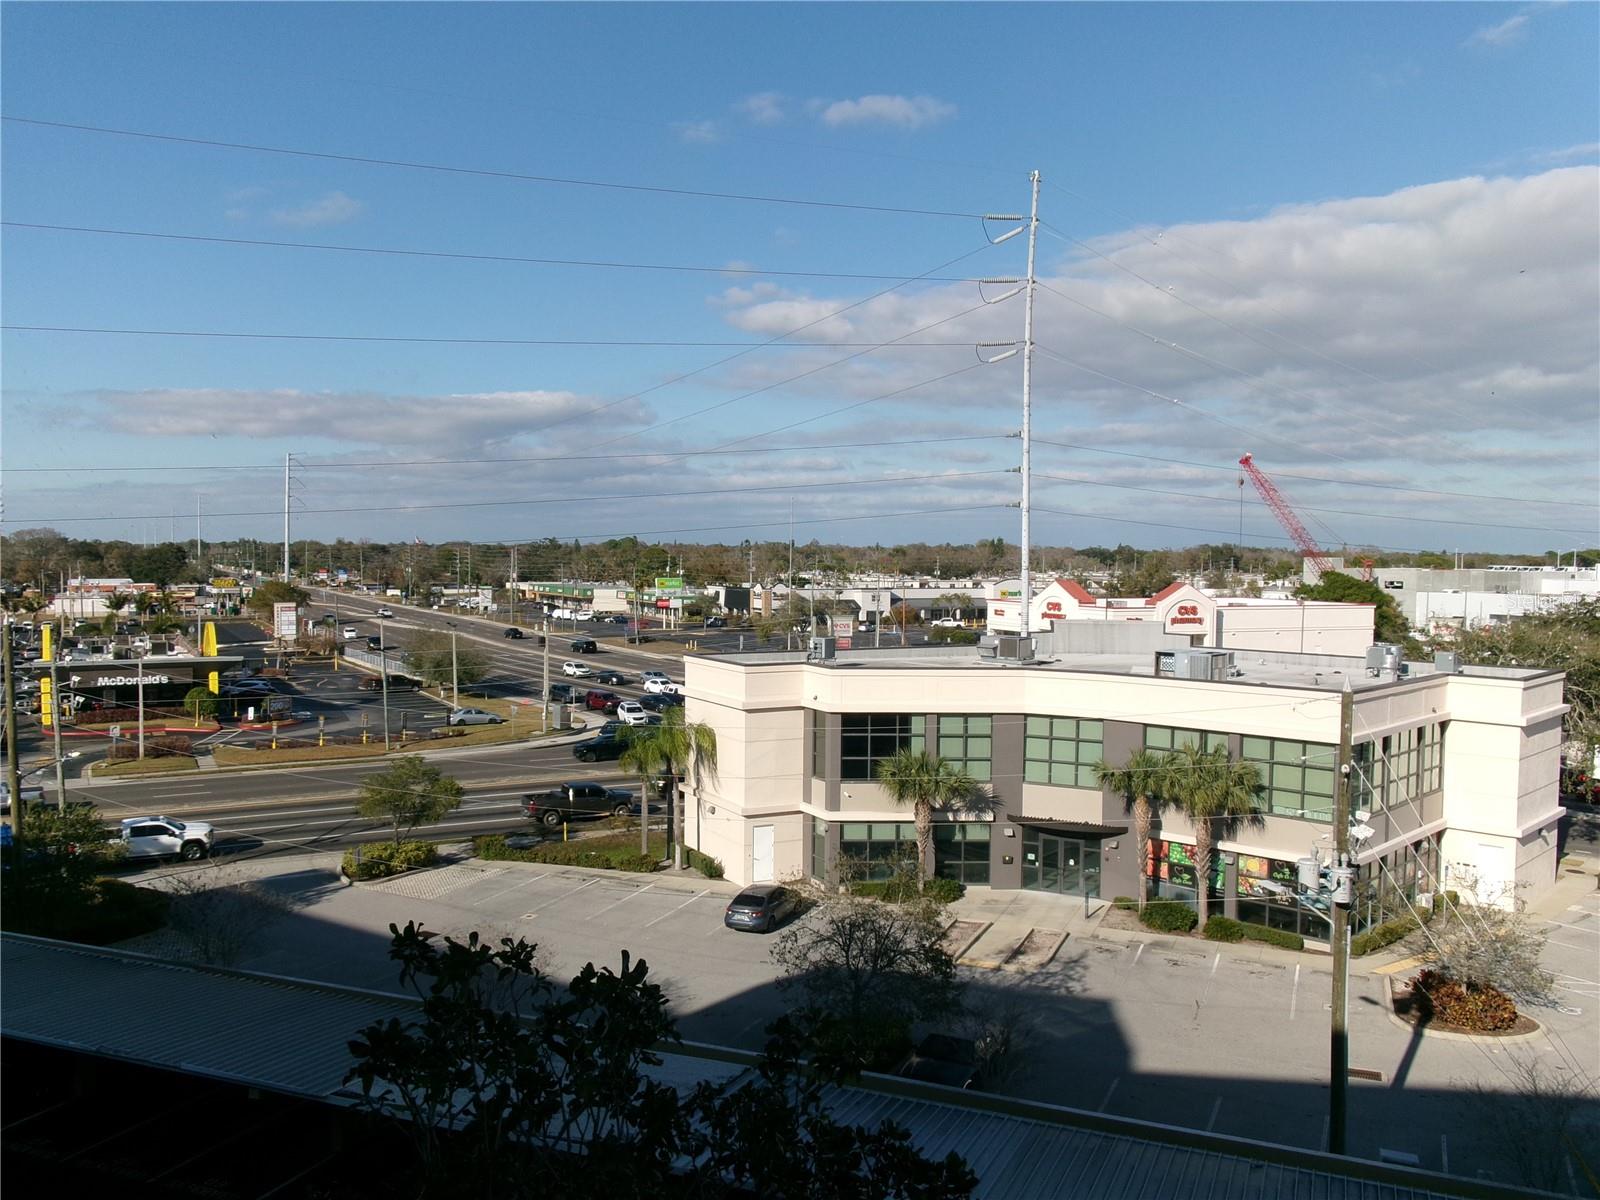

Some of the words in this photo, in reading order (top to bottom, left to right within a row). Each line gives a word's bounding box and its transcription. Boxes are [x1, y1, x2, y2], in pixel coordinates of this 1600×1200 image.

[1047, 602, 1062, 612] CVS
[1178, 605, 1198, 616] CVS
[97, 674, 169, 686] McDonald's
